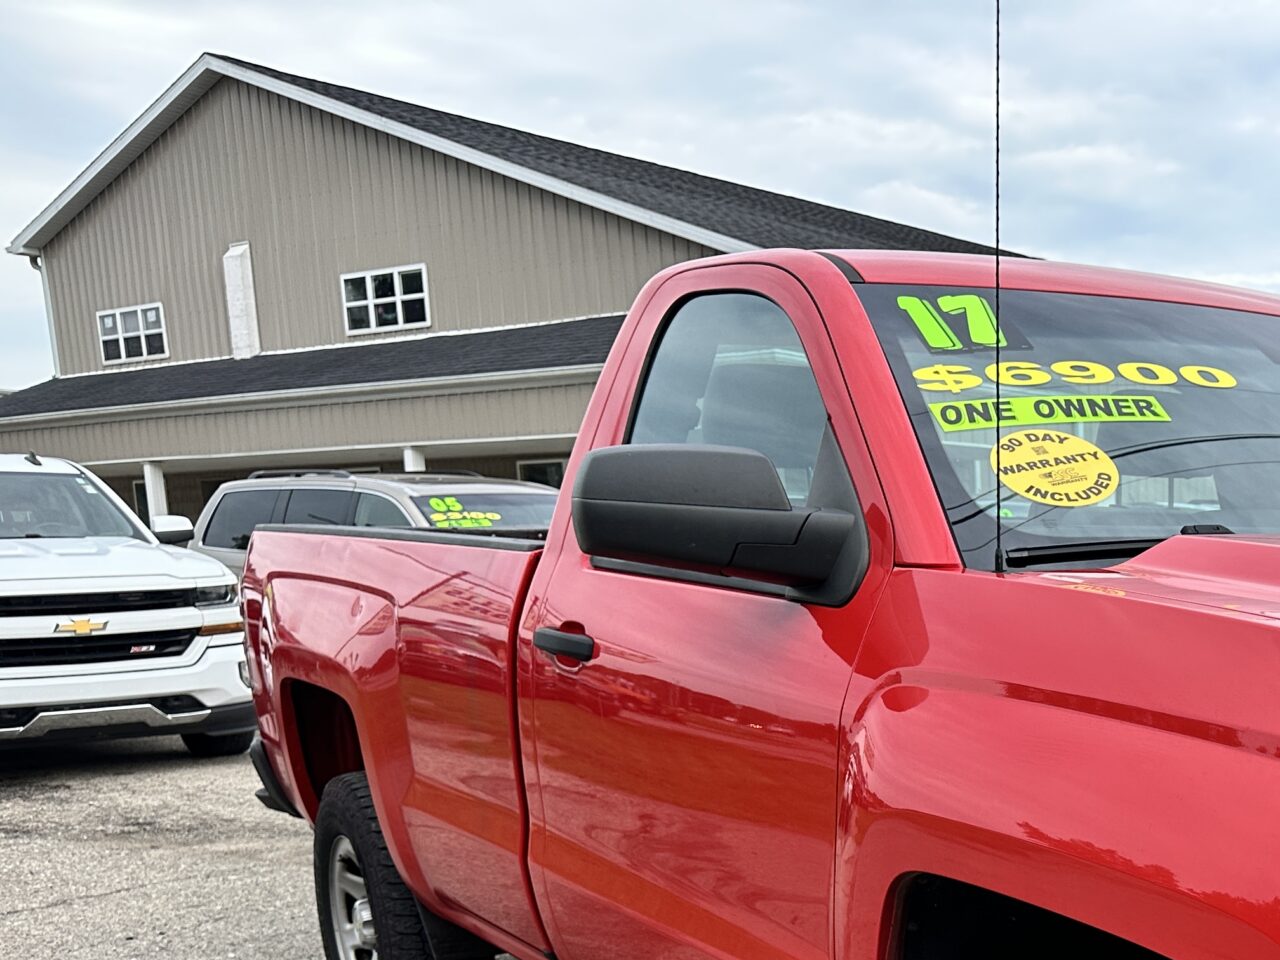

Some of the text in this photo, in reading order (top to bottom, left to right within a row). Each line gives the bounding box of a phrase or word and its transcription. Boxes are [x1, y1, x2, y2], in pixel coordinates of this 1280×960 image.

[897, 295, 1007, 349] 17
[912, 361, 1238, 393] $6900
[940, 398, 1158, 425] ONE OWNER
[1001, 433, 1070, 453] 90 DAY
[998, 451, 1100, 475] WARRANTY
[1024, 472, 1112, 502] INCLUDED
